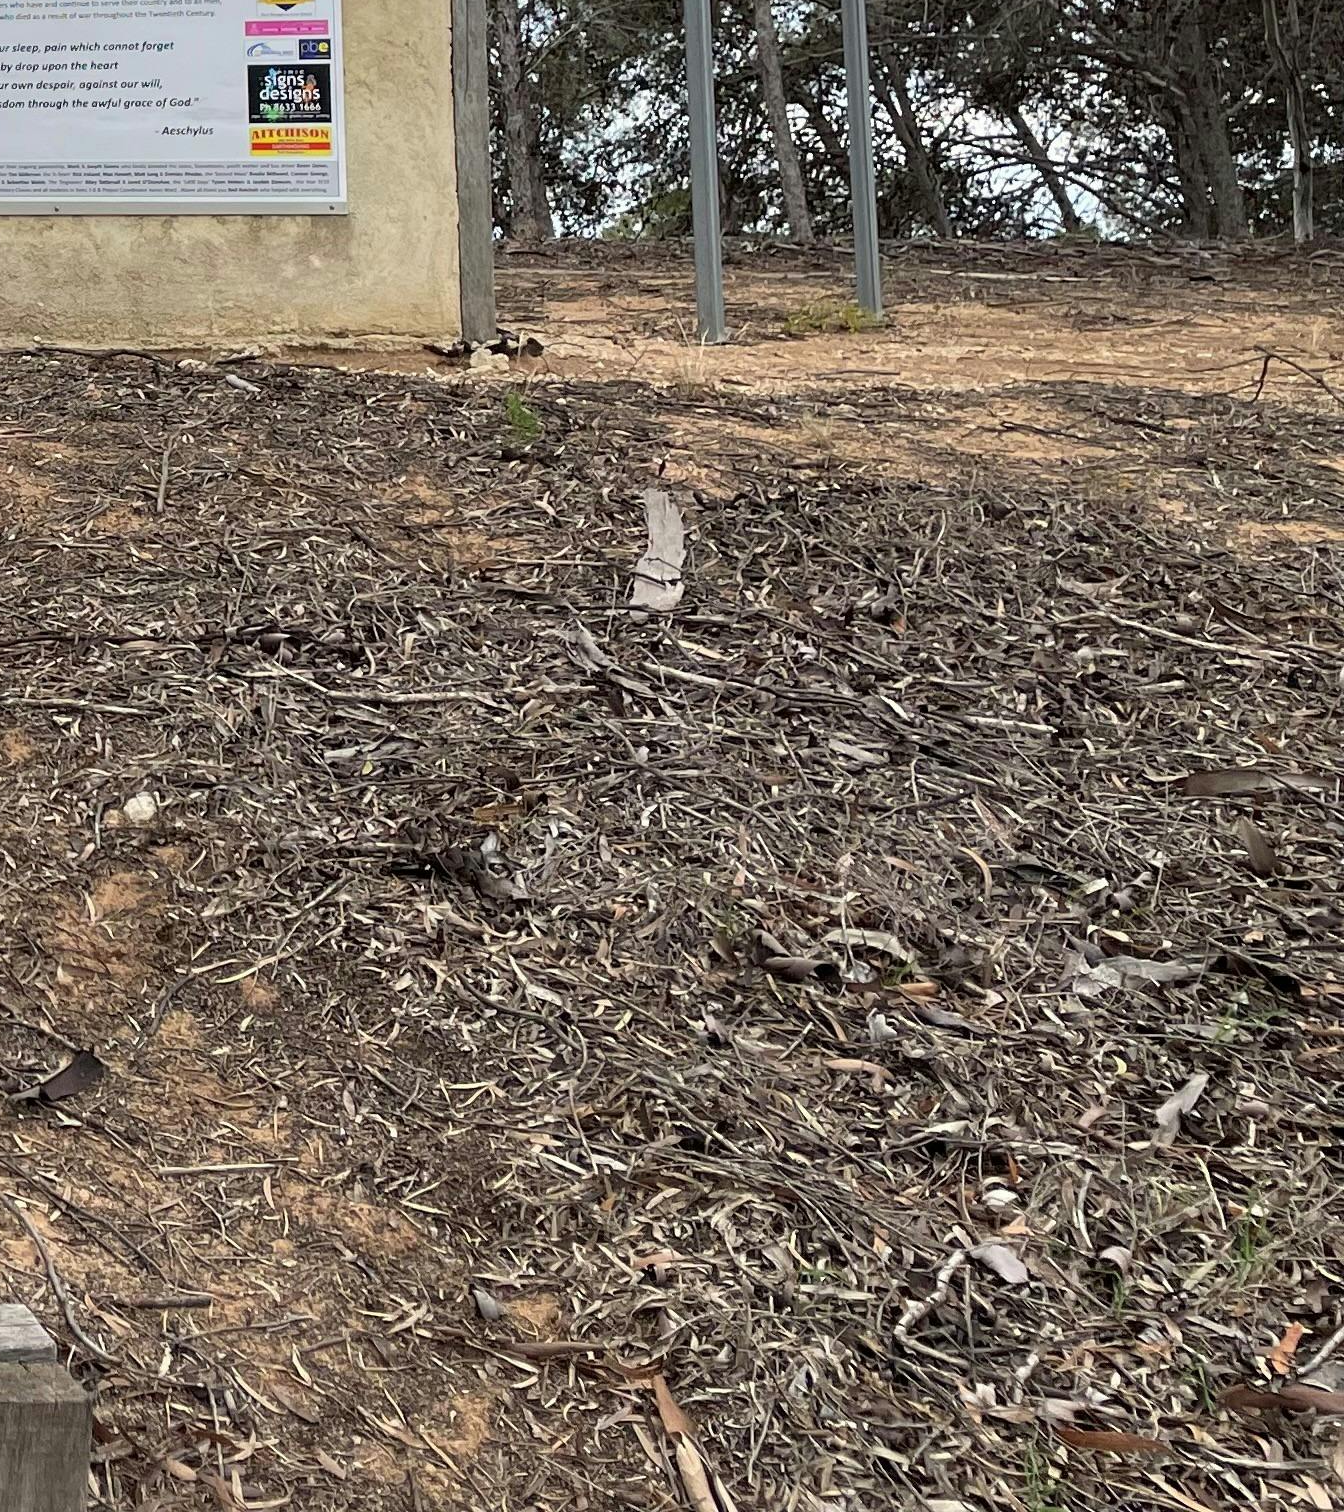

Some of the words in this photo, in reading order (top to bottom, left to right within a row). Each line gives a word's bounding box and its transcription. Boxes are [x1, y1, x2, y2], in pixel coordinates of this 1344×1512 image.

[11, 42, 42, 55] sleep,
[43, 42, 68, 54] pain
[70, 42, 101, 51] which
[102, 41, 140, 51] cannot
[140, 41, 174, 53] forget
[301, 41, 329, 57] pbe
[0, 62, 14, 74] by
[14, 61, 40, 74] drop
[41, 63, 68, 73] upon
[70, 61, 88, 70] the
[90, 60, 118, 70] heart
[10, 82, 34, 90] own
[78, 79, 118, 91] against
[140, 79, 163, 91] will,
[264, 74, 305, 89] signs
[259, 86, 321, 103] designs
[27, 98, 69, 111] through
[71, 98, 90, 108] the
[90, 98, 122, 110] awful
[122, 99, 154, 110] grace
[155, 98, 169, 110] of
[161, 126, 214, 137] Aeschylus
[252, 128, 329, 140] AITCHISON
